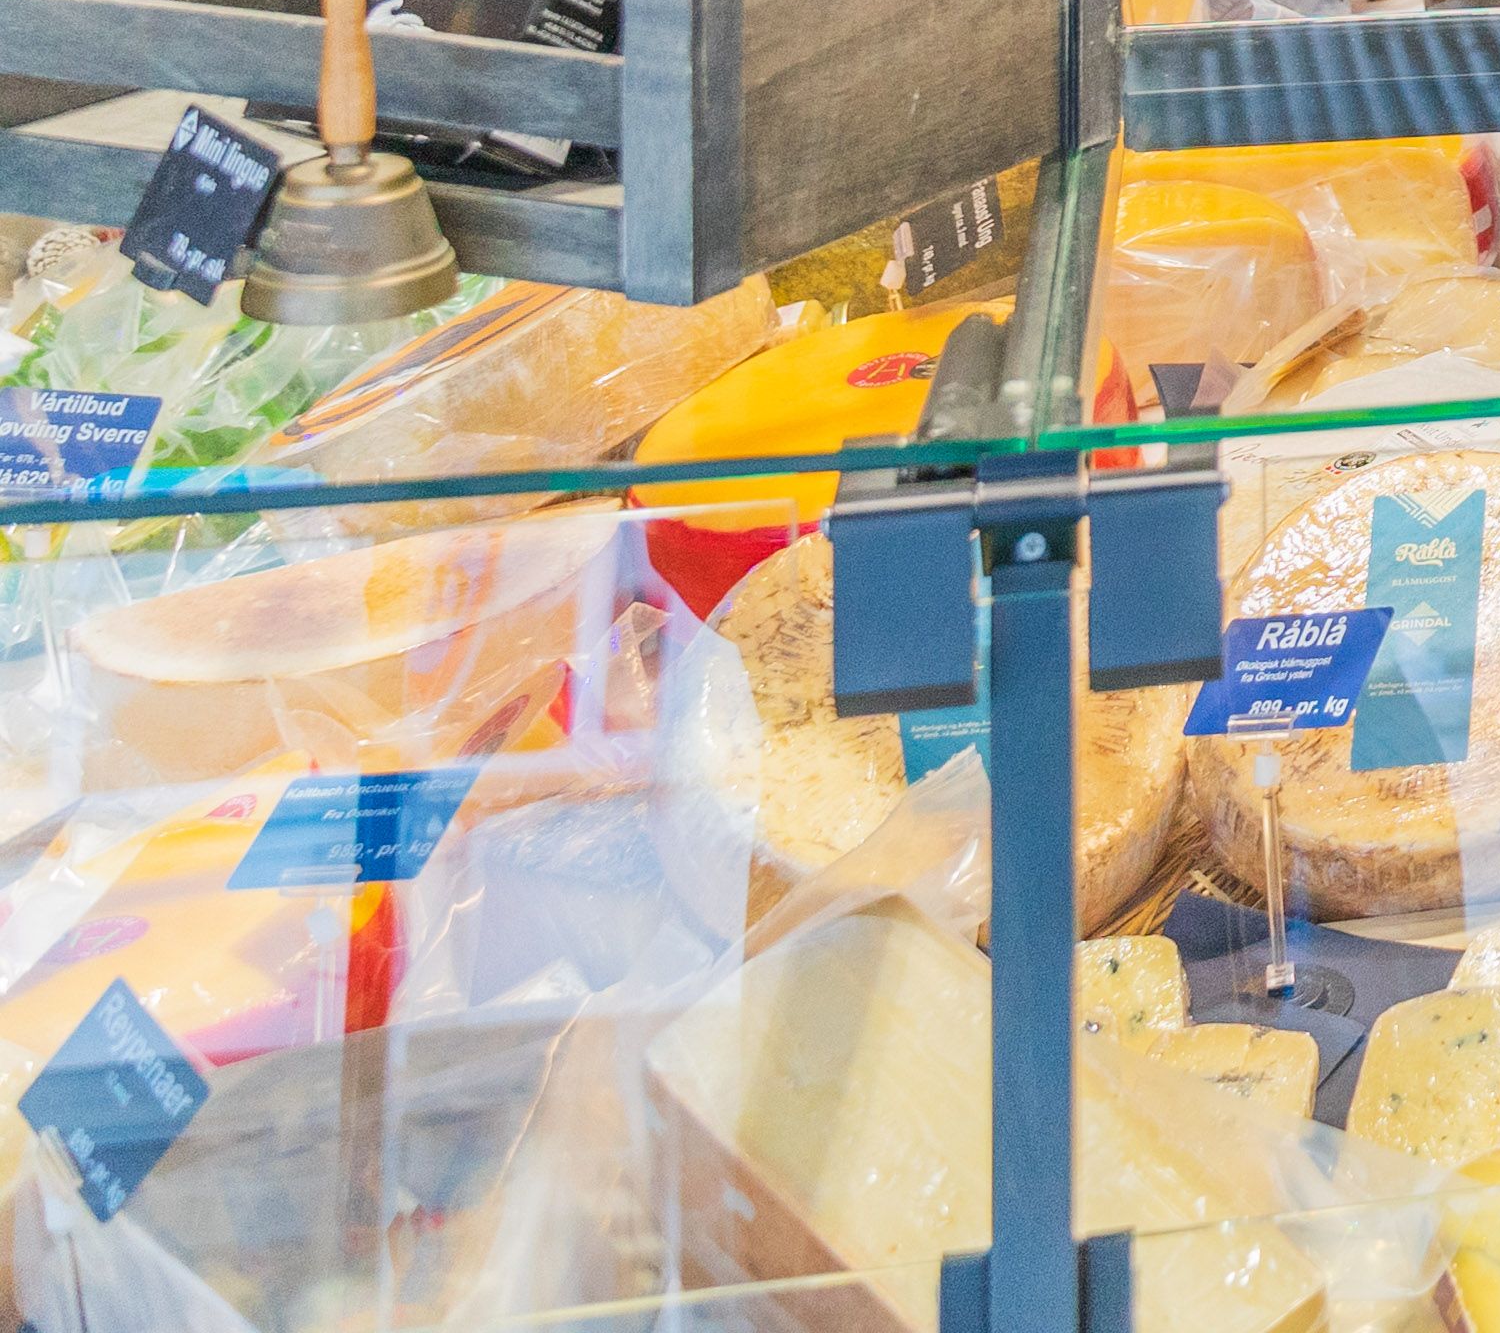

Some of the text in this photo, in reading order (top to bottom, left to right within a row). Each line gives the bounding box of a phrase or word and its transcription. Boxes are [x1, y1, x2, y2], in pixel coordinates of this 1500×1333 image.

[189, 124, 231, 166] Mini
[218, 141, 271, 193] lingue
[30, 390, 130, 417] Vårtilbud
[75, 422, 149, 445] Sverre
[1395, 536, 1458, 566] Råblå
[1255, 614, 1348, 651] Råblå
[1390, 616, 1452, 631] GRINDAL
[1294, 701, 1319, 715] pr.
[1323, 695, 1349, 718] kg
[98, 991, 195, 1119] Reypenaer
